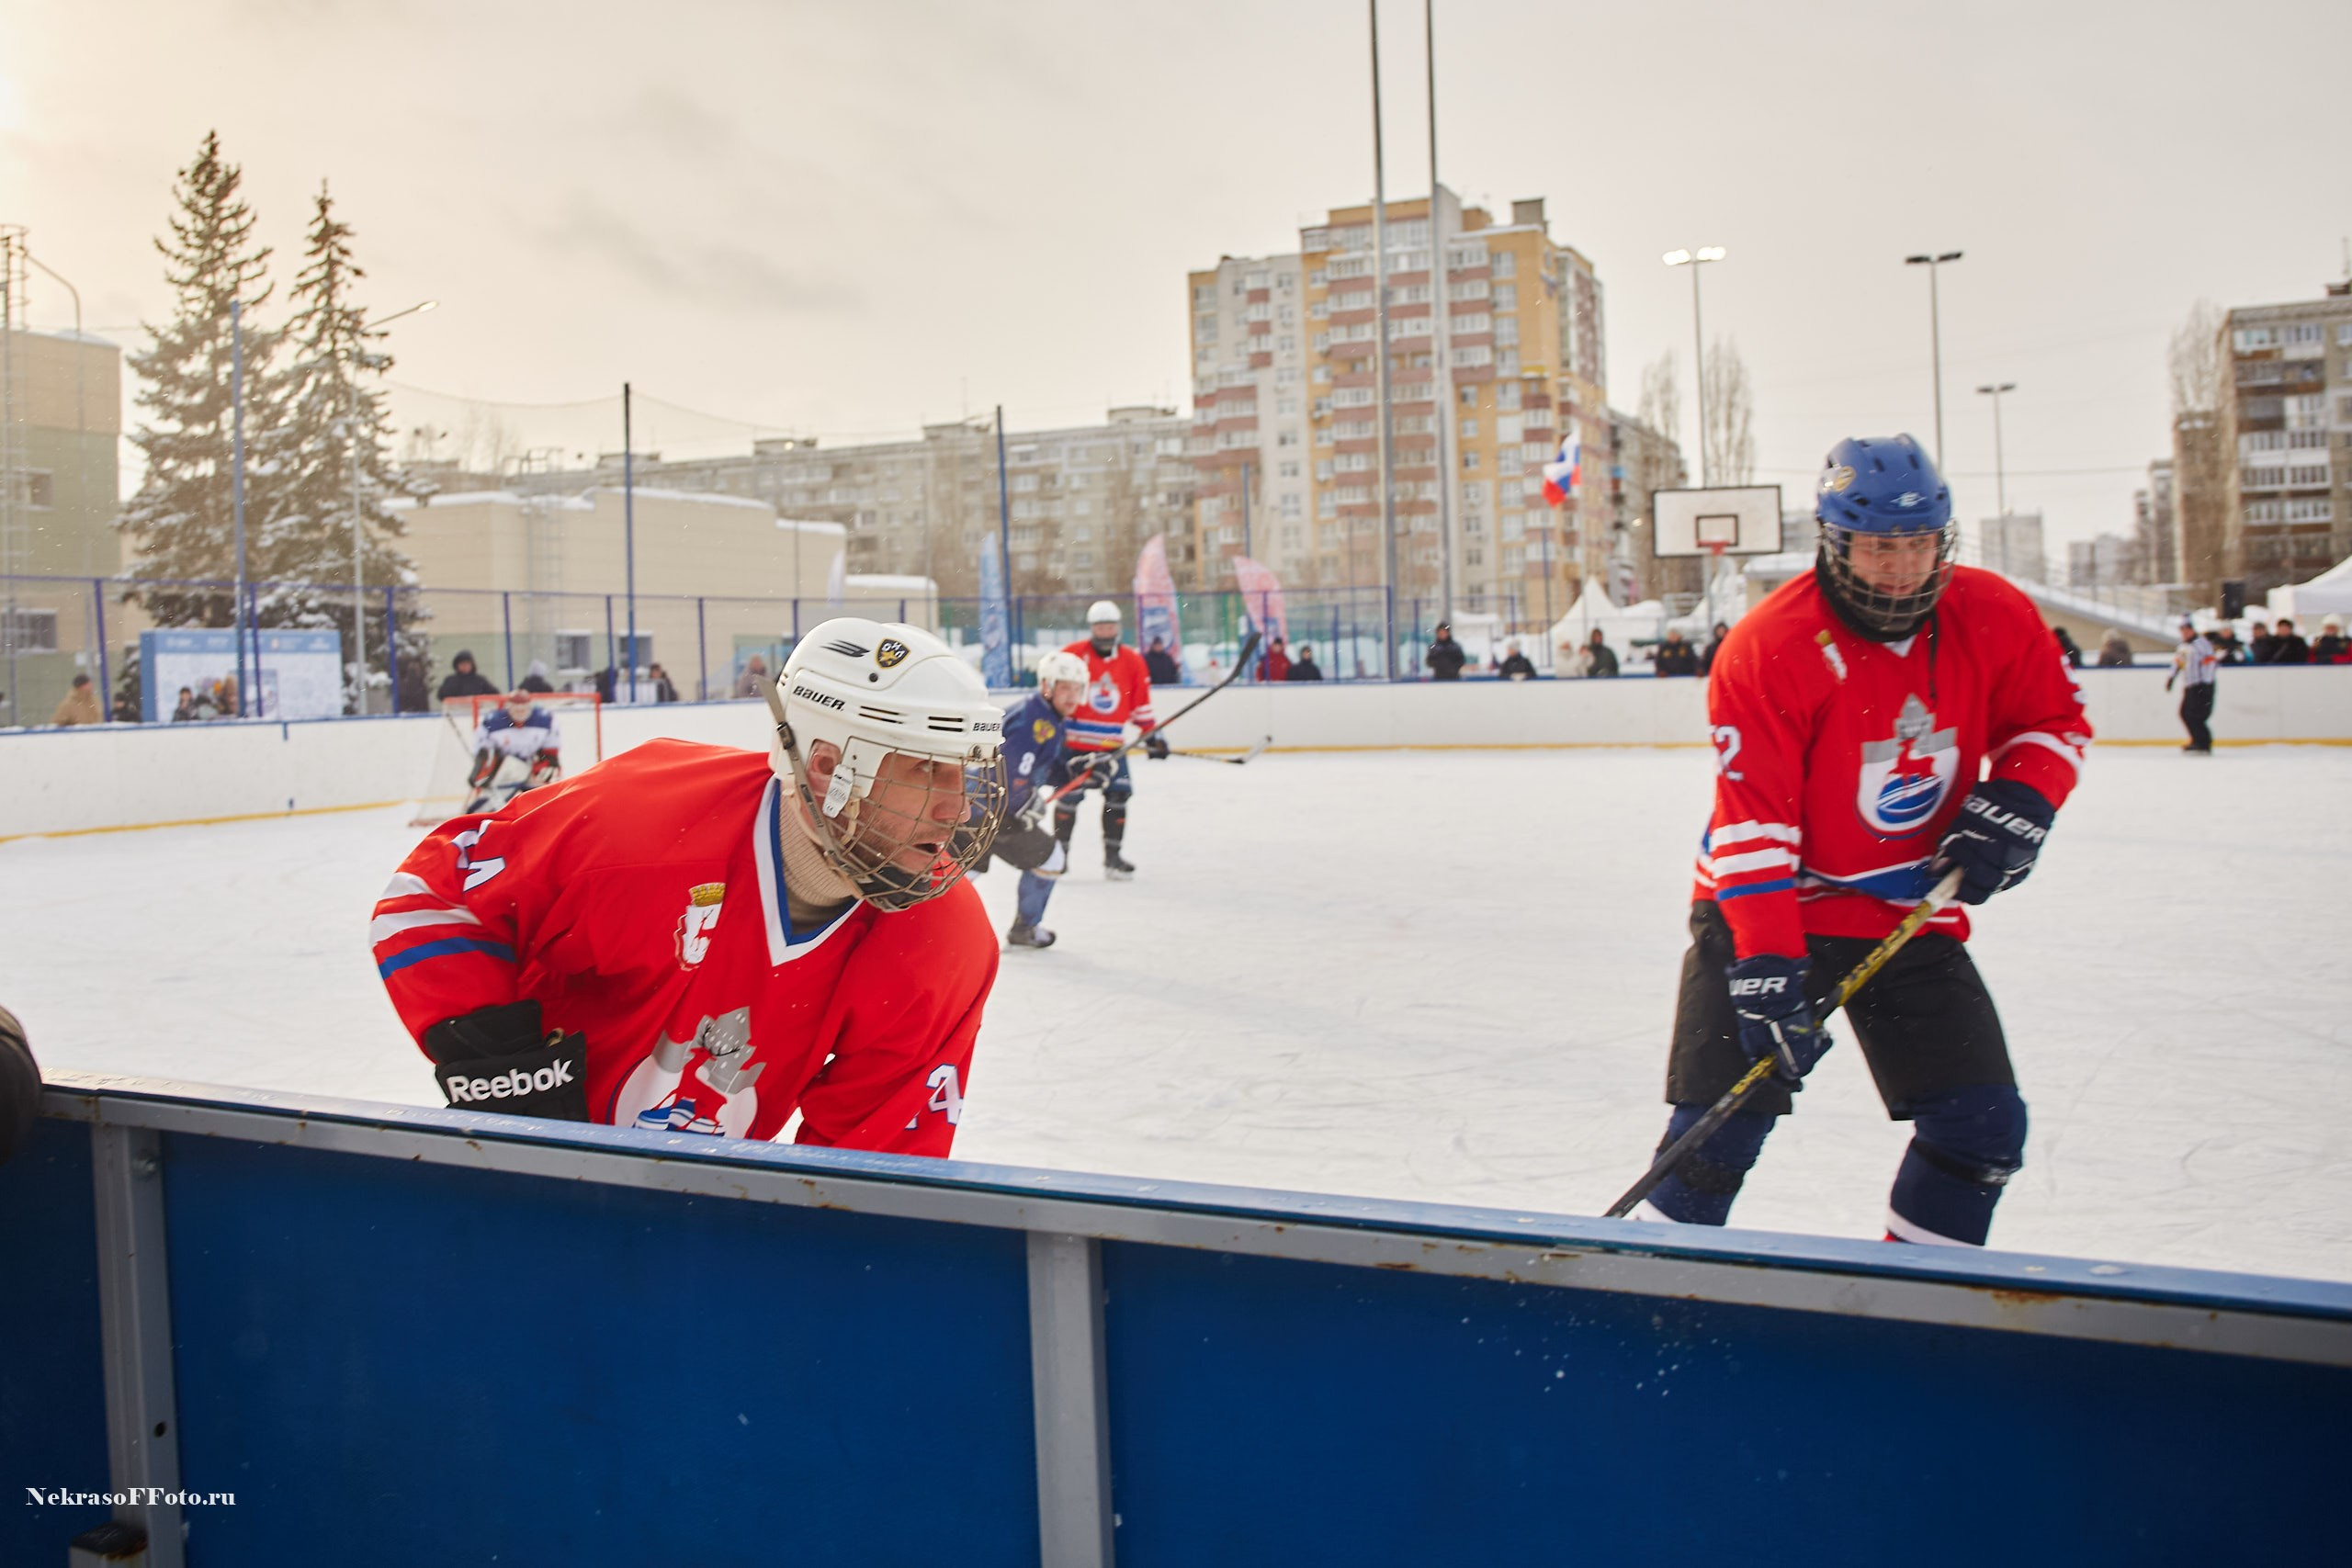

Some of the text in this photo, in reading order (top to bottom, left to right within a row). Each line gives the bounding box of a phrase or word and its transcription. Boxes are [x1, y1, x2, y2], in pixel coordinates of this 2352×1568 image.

[793, 685, 845, 710] BAUER
[1018, 751, 1035, 776] 8
[1709, 724, 1744, 781] 2
[1729, 976, 1788, 997] UER
[447, 1058, 574, 1103] Reebok
